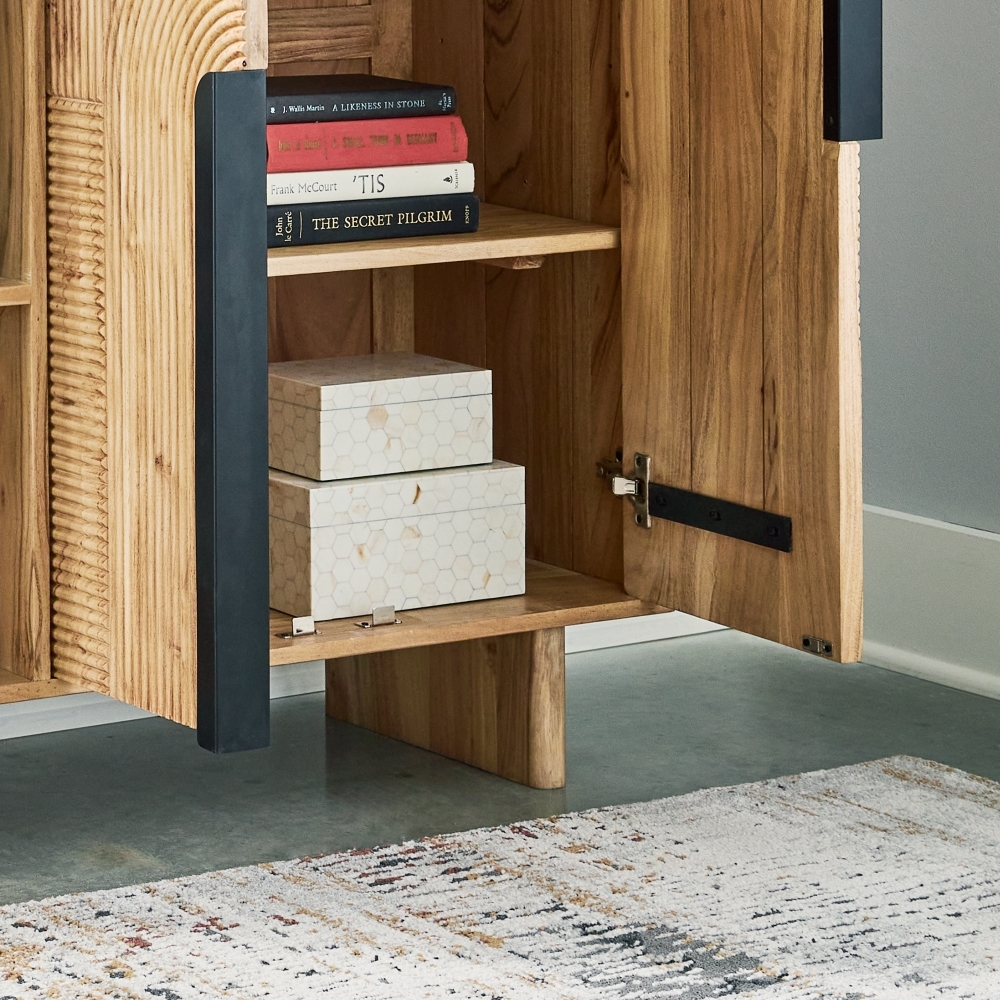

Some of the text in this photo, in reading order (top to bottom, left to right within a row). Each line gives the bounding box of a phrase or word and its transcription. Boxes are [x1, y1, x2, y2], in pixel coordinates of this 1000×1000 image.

[282, 106, 288, 114] J.
[332, 104, 338, 112] A
[340, 102, 381, 112] LIKENESS
[384, 101, 394, 109] IN
[396, 99, 426, 109] STONE
[270, 182, 338, 196] Frank McCourt
[284, 211, 293, 242] le Carré
[312, 209, 453, 231] THE SECRET PILGRIM
